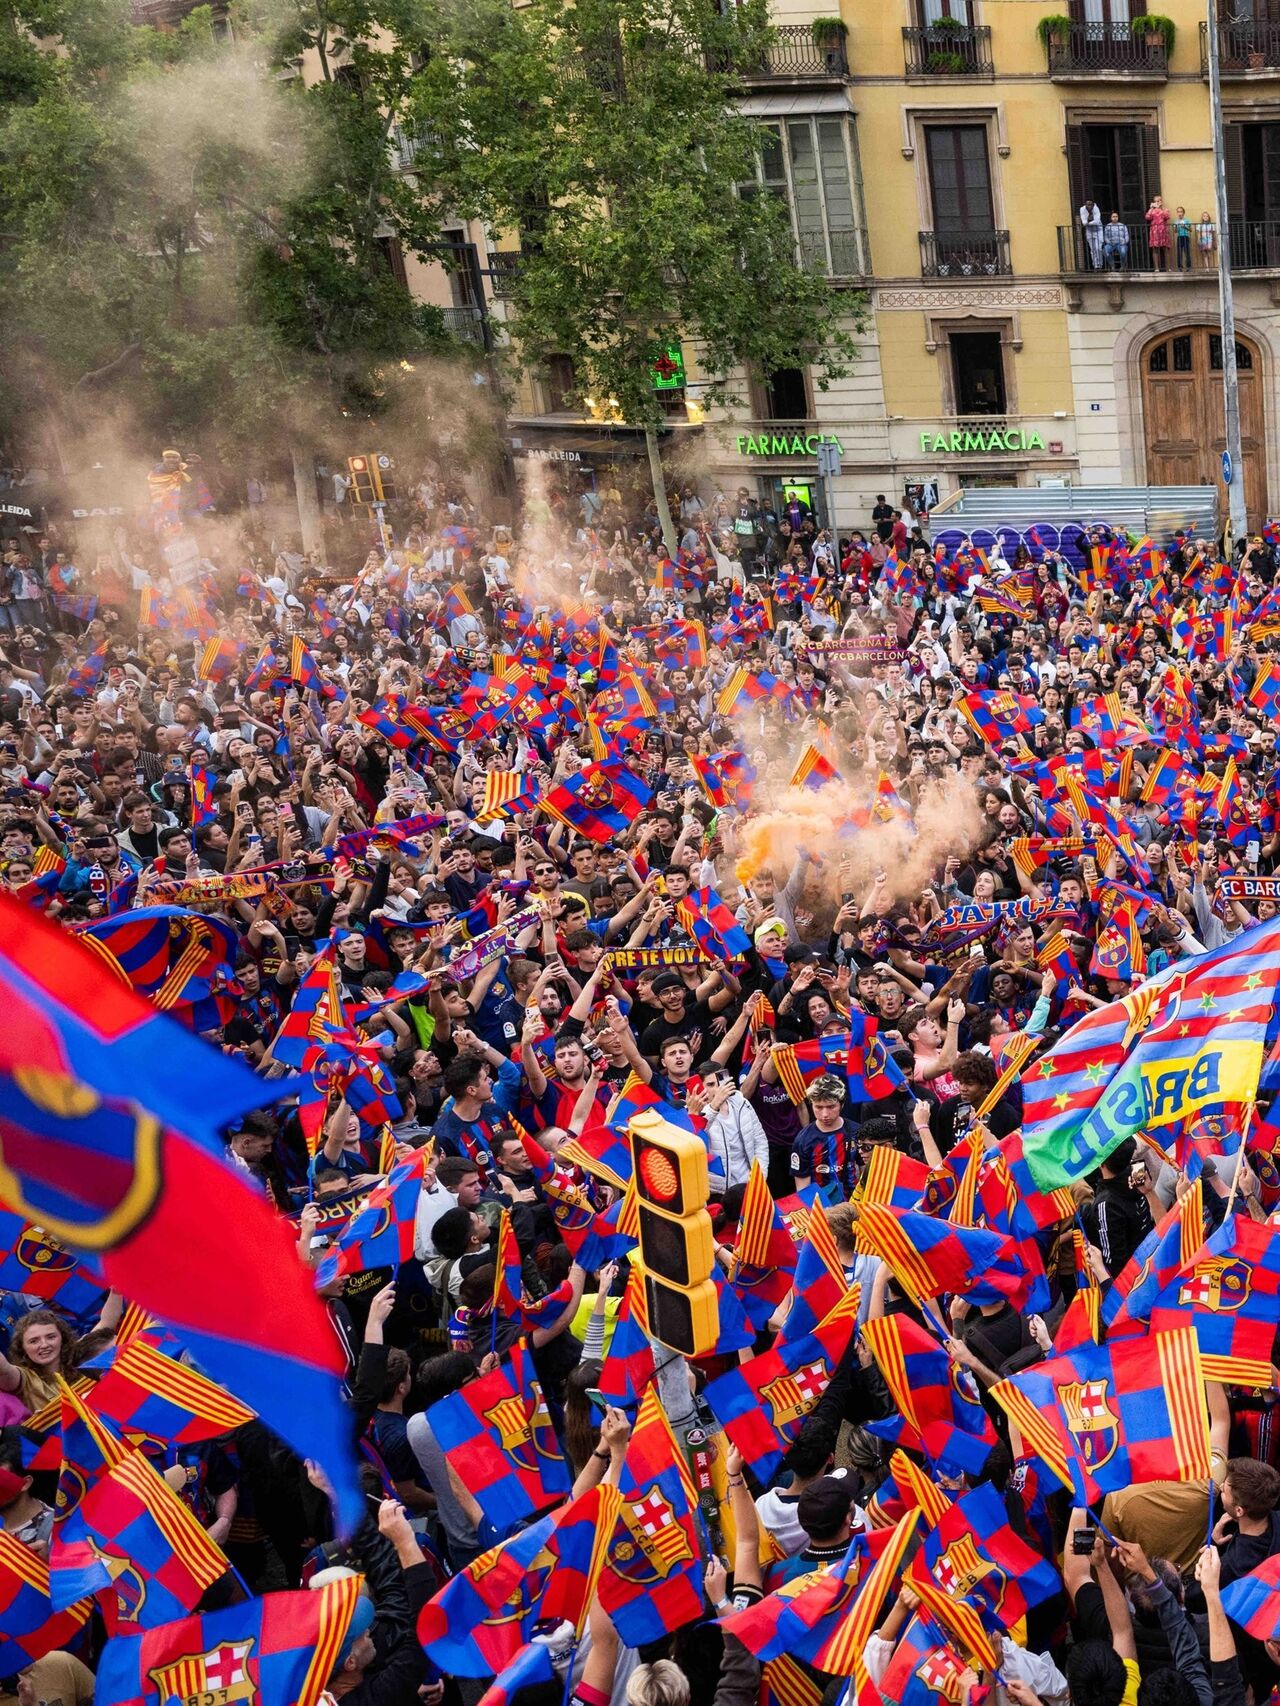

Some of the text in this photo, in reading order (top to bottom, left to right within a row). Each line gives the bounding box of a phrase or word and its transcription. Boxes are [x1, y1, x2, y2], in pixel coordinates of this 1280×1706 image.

[919, 430, 1046, 453] FARMACIA
[548, 450, 581, 462] LLEIDA
[0, 503, 33, 518] LEIDA
[72, 506, 123, 518] BAR
[1220, 880, 1242, 896] FC
[639, 950, 660, 966] TE
[661, 948, 697, 965] VOY
[349, 1271, 374, 1288] Qatar
[630, 1523, 655, 1555] FCB
